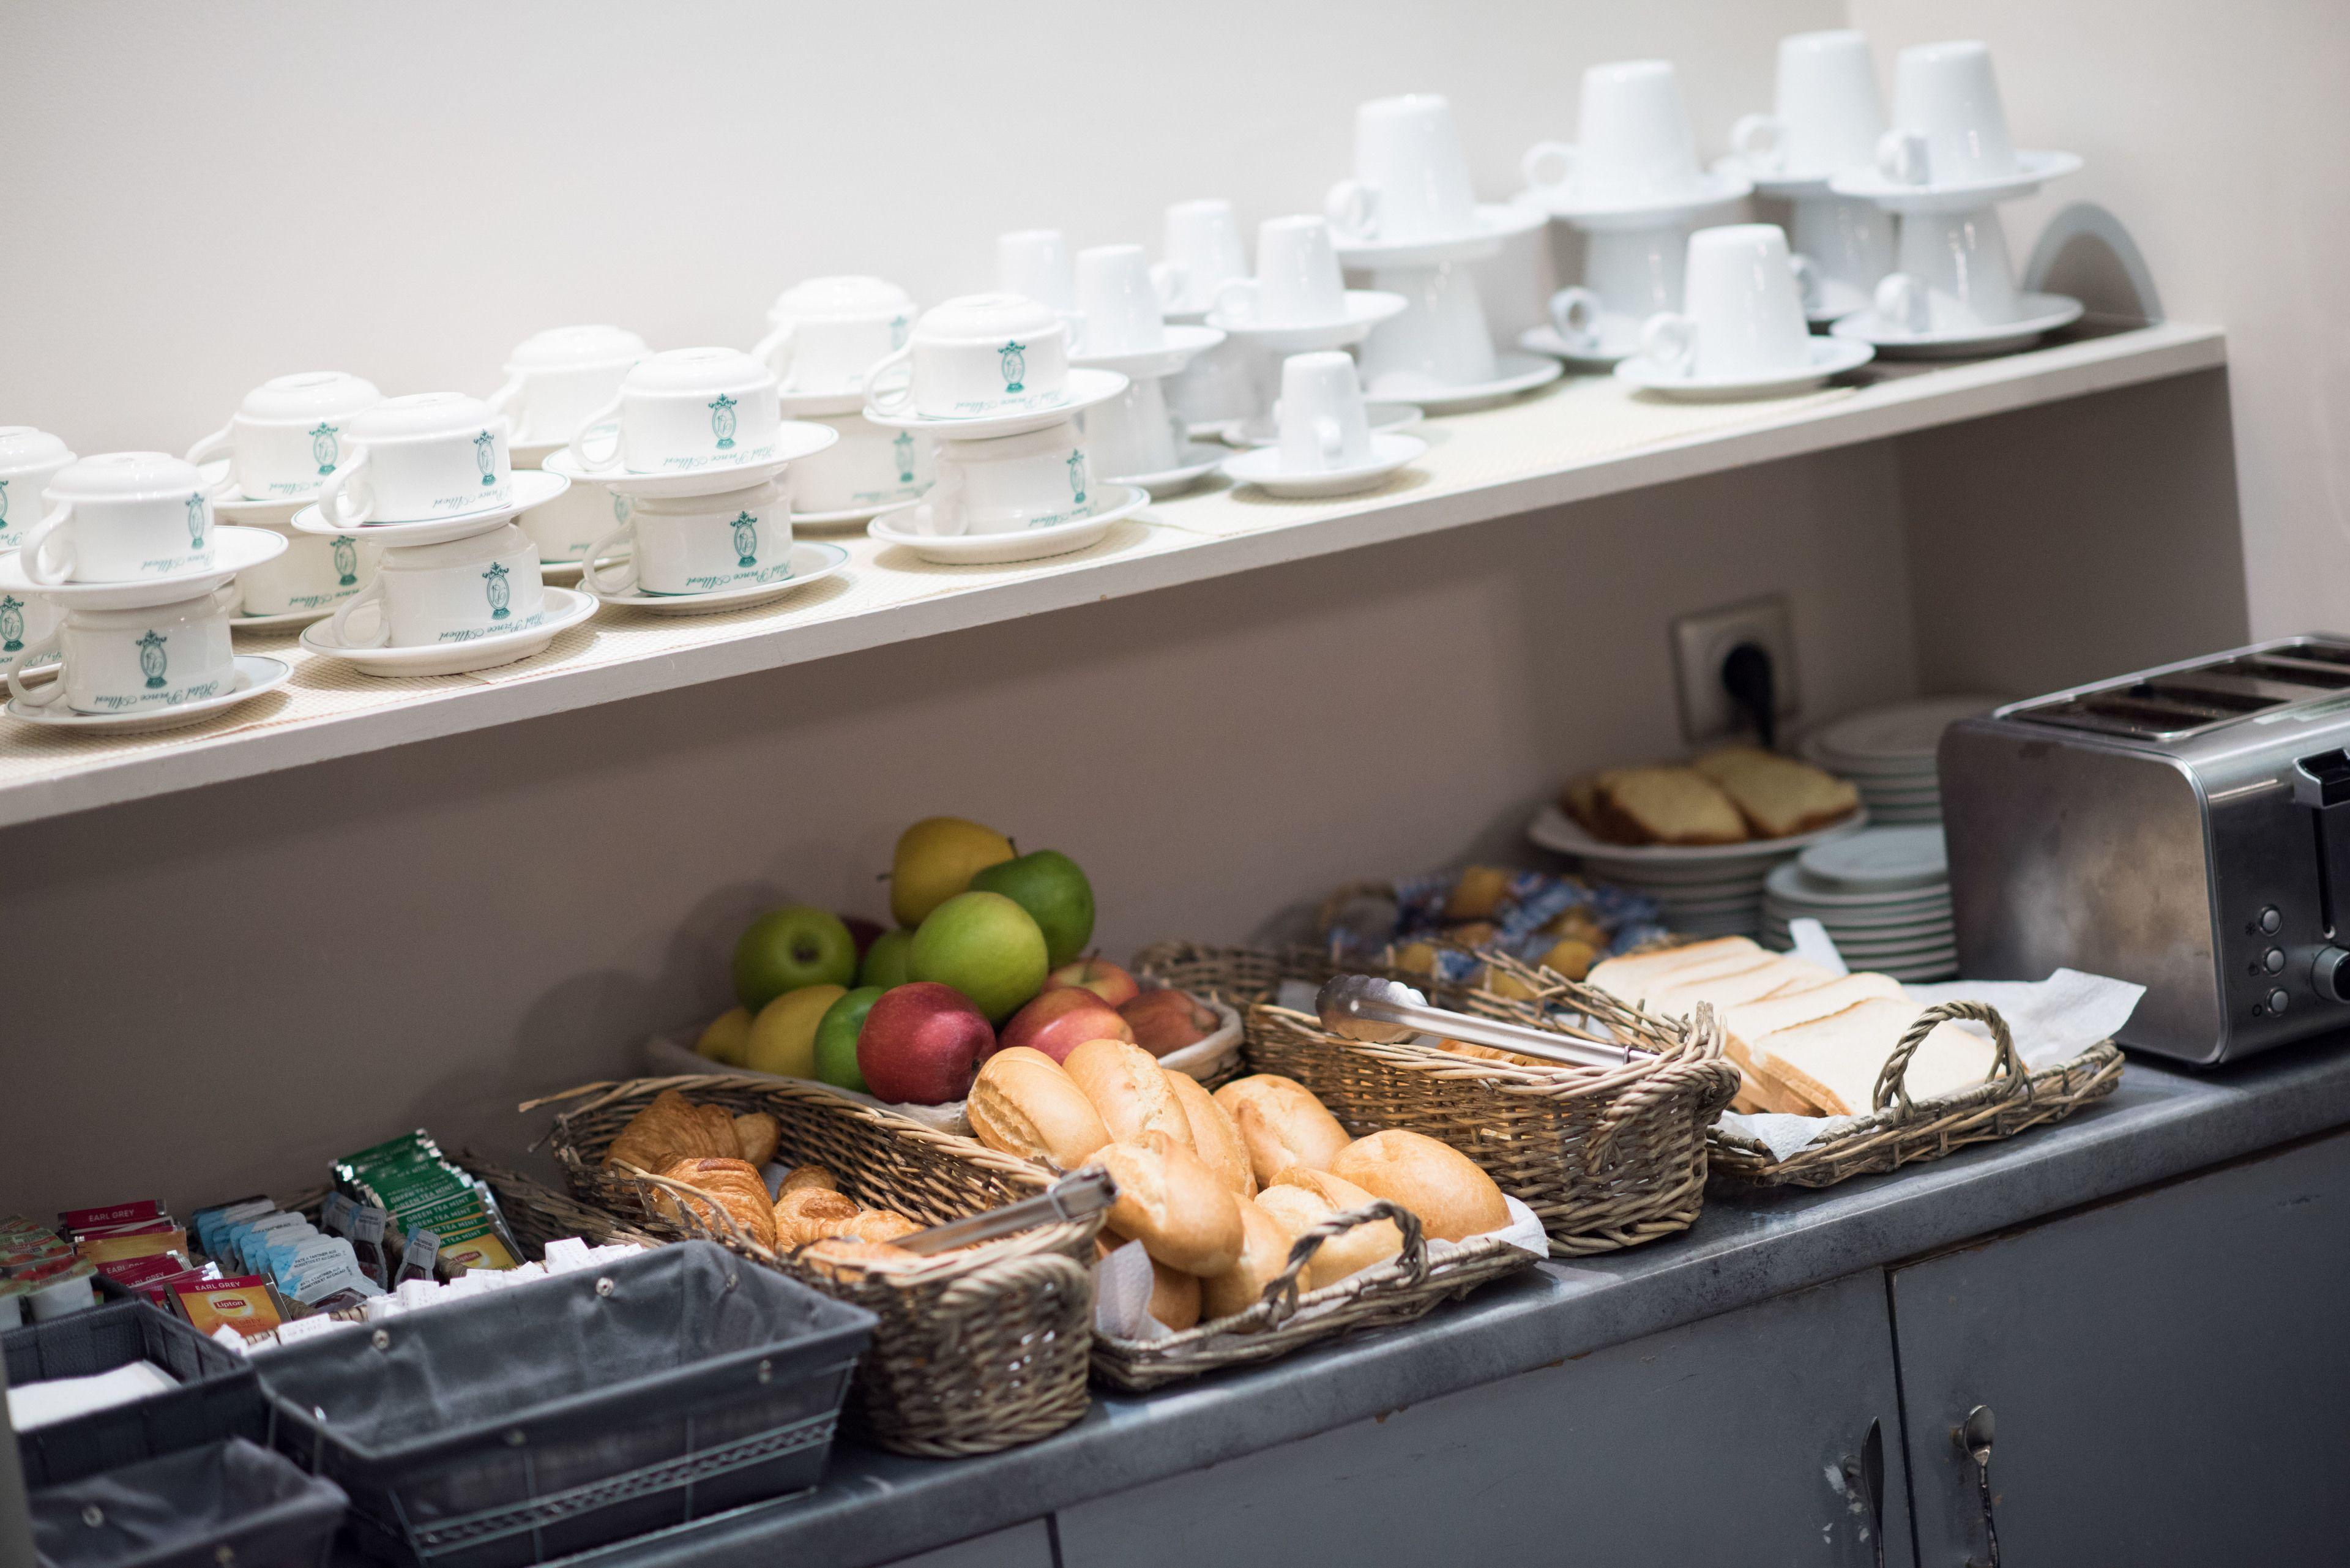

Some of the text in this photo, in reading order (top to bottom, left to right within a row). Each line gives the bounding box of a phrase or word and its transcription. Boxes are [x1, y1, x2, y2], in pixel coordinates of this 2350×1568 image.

[663, 455, 708, 470] Albert
[710, 450, 750, 464] Prince
[432, 493, 476, 510] Albert
[141, 557, 185, 573] Albert
[685, 575, 731, 590] Albert
[733, 567, 769, 583] Prince
[288, 595, 333, 609] Albert
[487, 618, 523, 633] Prince
[438, 628, 484, 642] Albert
[92, 695, 138, 709] Albert
[140, 689, 183, 706] Prince
[421, 1192, 435, 1201] TEA
[435, 1183, 455, 1194] MINT
[89, 1209, 135, 1223] EARL GREY
[406, 1197, 469, 1222] GREEN TEA MINT
[406, 1208, 471, 1229] GREEN TEA MINT
[458, 1219, 478, 1228] MINT
[461, 1230, 481, 1239] MINT
[195, 1283, 217, 1291] EARL
[216, 1299, 244, 1309] Lipton
